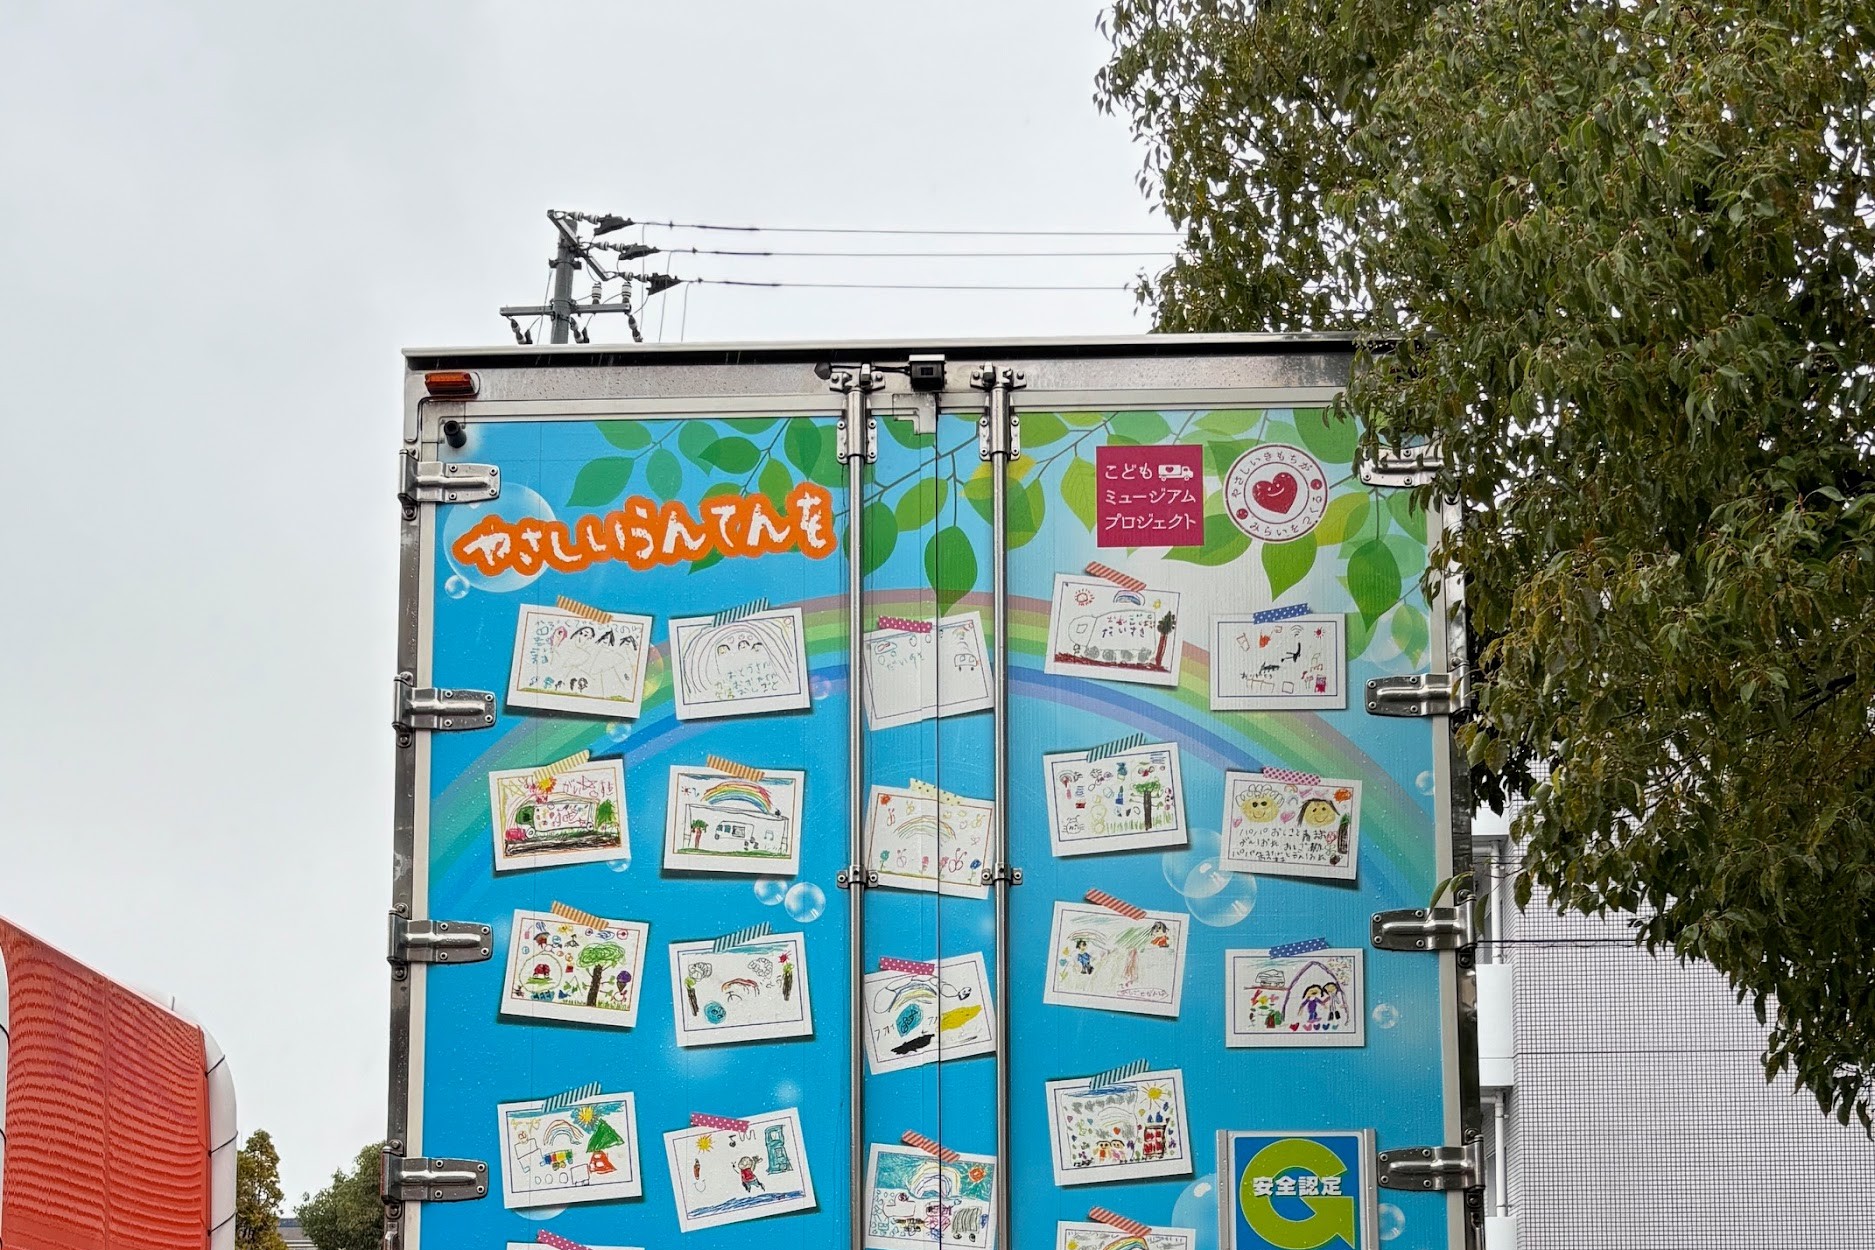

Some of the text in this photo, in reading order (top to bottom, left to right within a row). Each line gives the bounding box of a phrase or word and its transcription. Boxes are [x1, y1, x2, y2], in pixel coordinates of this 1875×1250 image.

[1105, 462, 1152, 480] こども
[1105, 487, 1196, 505] ミュージアム
[1105, 513, 1196, 530] プロジェクト
[1252, 1175, 1342, 1197] 安全認定
